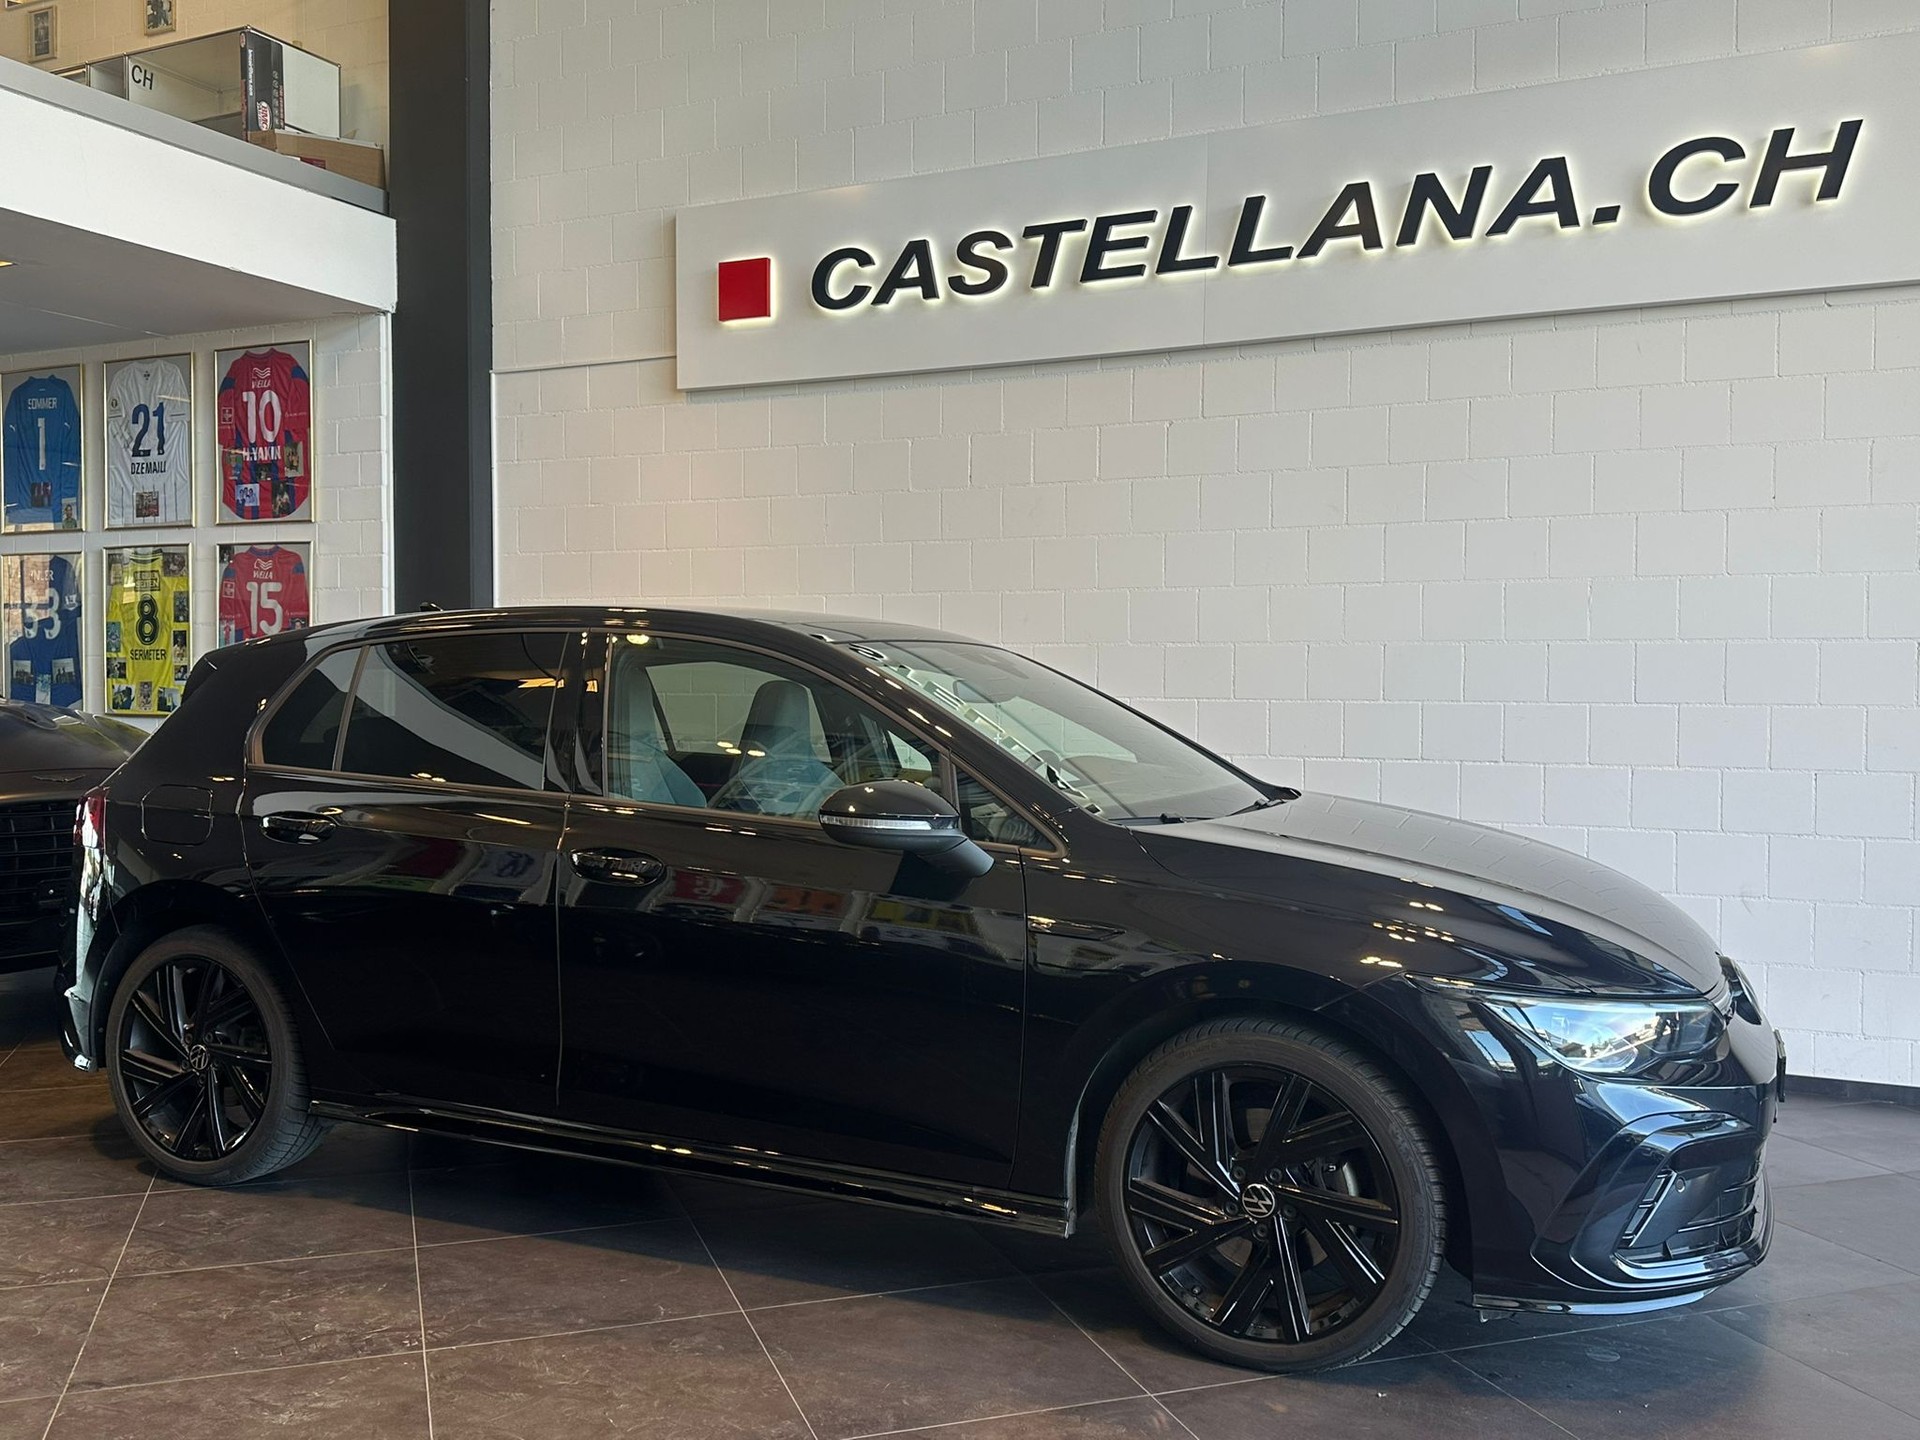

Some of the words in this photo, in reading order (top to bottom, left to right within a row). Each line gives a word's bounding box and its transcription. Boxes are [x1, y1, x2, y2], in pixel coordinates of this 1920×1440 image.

[131, 64, 154, 90] CH
[811, 119, 1864, 310] CASTELLANA.CH
[27, 397, 57, 410] SOMMER
[131, 402, 166, 457] 21
[242, 390, 282, 443] 10
[37, 418, 46, 471] 1
[130, 461, 167, 475] DZEMAILI
[242, 445, 281, 461] H.YAKIN
[136, 593, 160, 646] 8
[246, 582, 283, 635] 15
[130, 649, 167, 661] SERMETER
